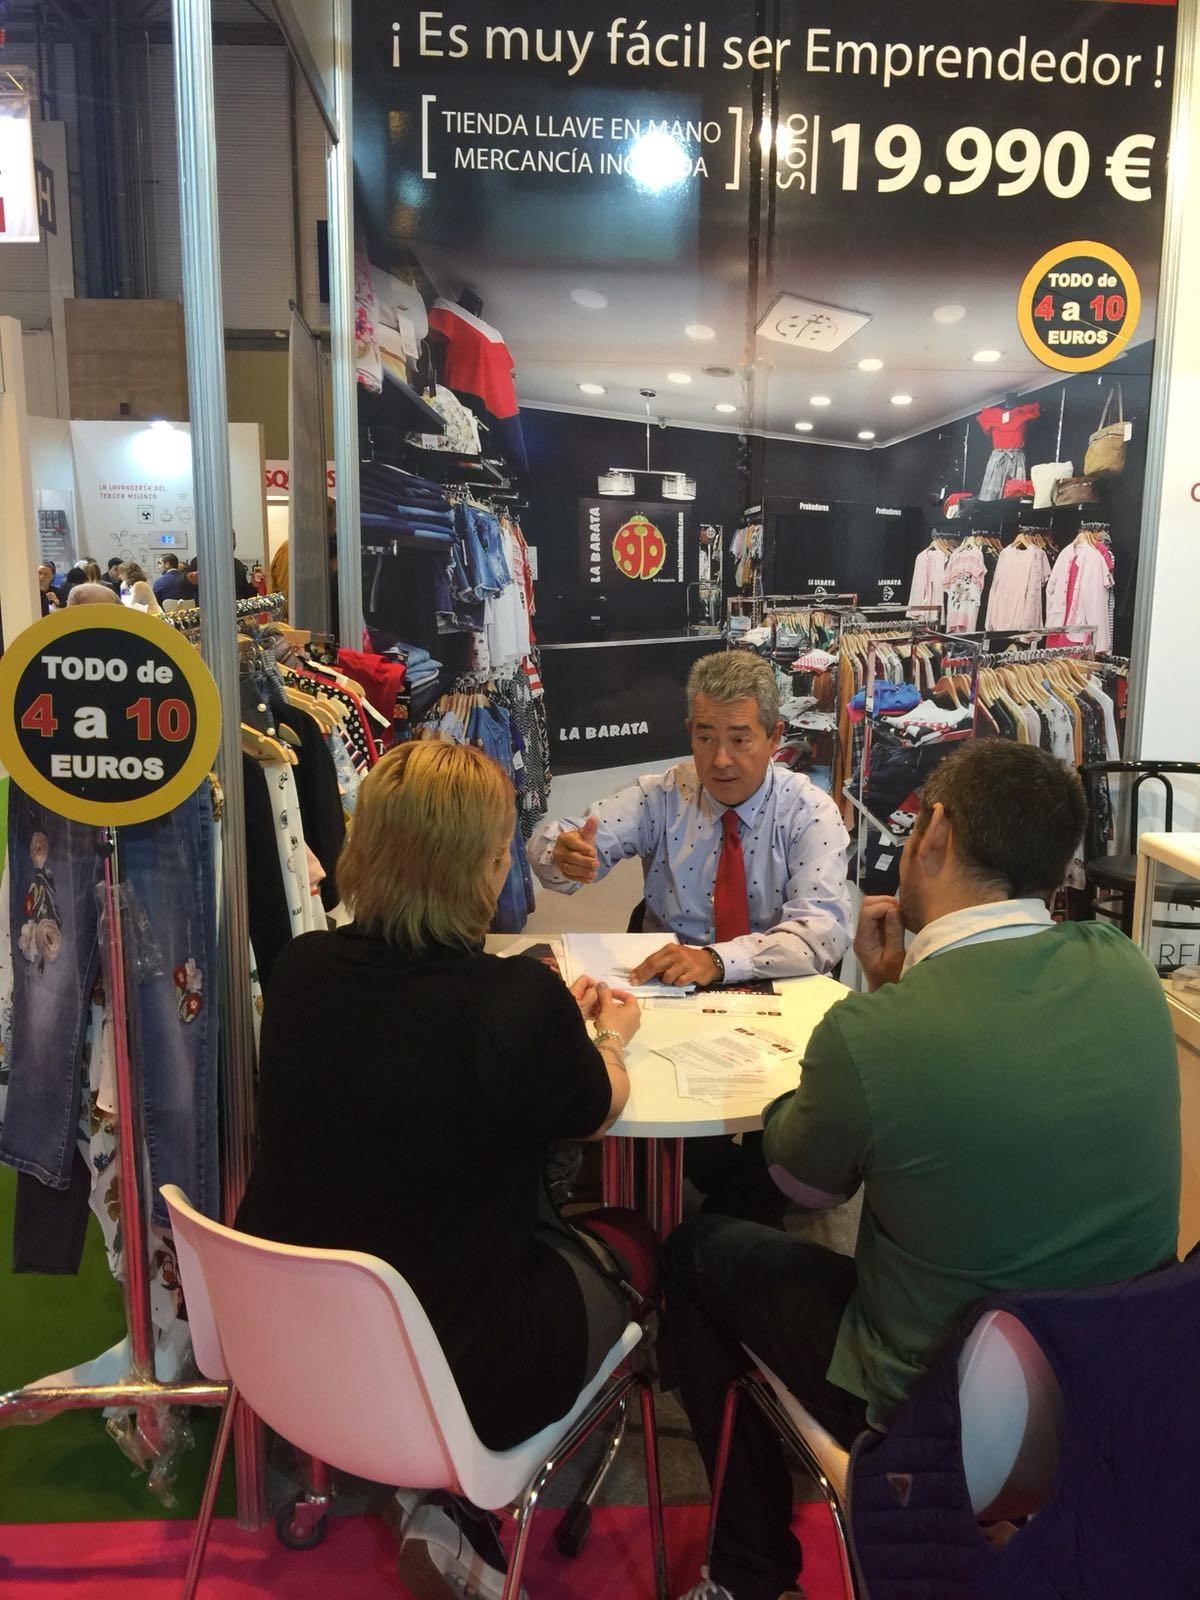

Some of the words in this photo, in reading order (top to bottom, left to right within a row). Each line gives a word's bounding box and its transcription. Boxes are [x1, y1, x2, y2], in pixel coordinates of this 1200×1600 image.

[419, 11, 469, 58] Es
[486, 26, 594, 76] muy
[607, 17, 706, 68] fácil
[722, 35, 791, 72] ser
[806, 28, 1142, 88] Emprendedor
[441, 111, 528, 136] TIENDA
[535, 115, 604, 139] LLAVE
[611, 118, 640, 140] EN
[454, 147, 593, 174] MERCANCÍA
[831, 123, 1090, 199] 19.990
[1105, 133, 1156, 202] €
[1048, 273, 1094, 287] TODO
[1097, 273, 1118, 287] de
[1034, 295, 1055, 321] 4
[1061, 301, 1080, 321] a
[1090, 294, 1125, 321] 10
[1048, 330, 1108, 345] EUROS
[588, 507, 601, 562] BARATA
[589, 566, 601, 583] LA
[41, 656, 128, 682] TODO
[136, 660, 174, 684] de
[21, 693, 58, 737] 4
[73, 706, 108, 739] a
[126, 698, 191, 742] 10
[559, 727, 581, 741] LA
[585, 721, 649, 740] BARATA
[51, 754, 165, 781] EUROS
